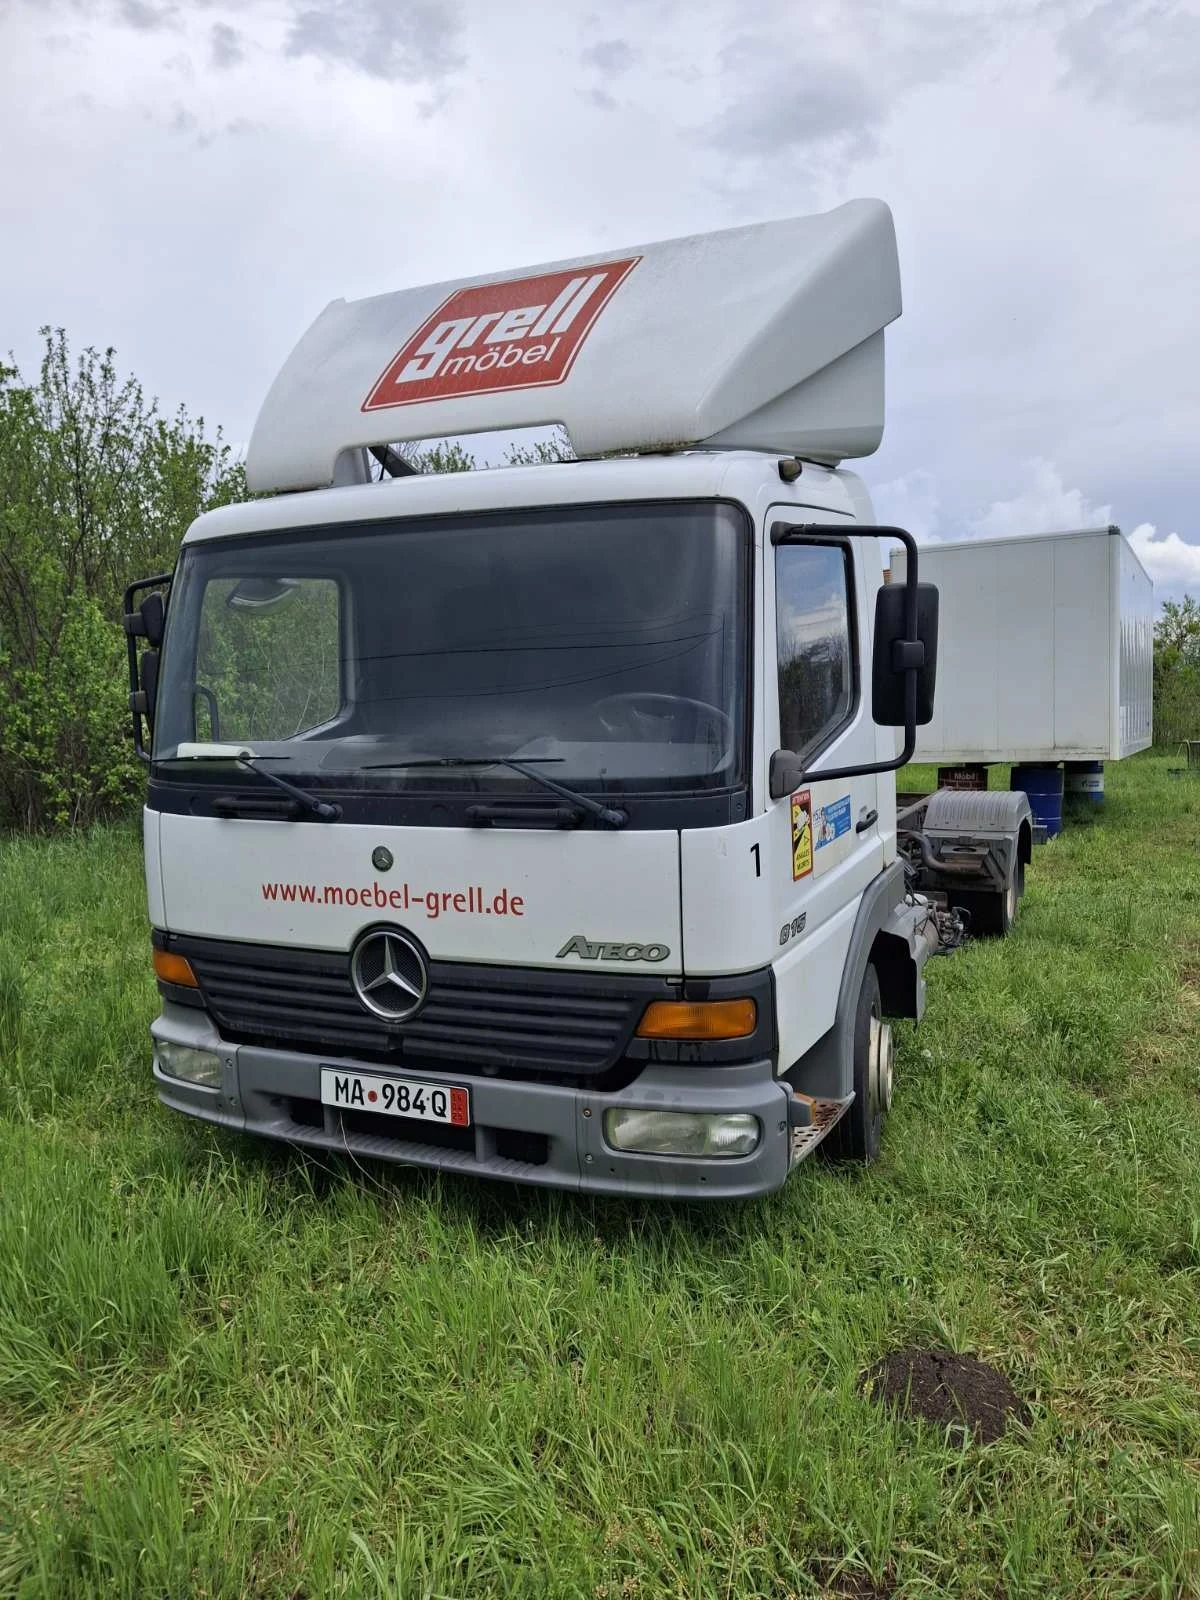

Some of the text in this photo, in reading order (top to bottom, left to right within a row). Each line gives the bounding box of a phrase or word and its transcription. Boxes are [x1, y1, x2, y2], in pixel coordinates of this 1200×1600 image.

[395, 272, 609, 384] grell
[439, 337, 562, 377] möbel
[750, 842, 761, 878] 1
[262, 882, 525, 918] www.moebel-grell.de
[335, 1076, 365, 1105] MA
